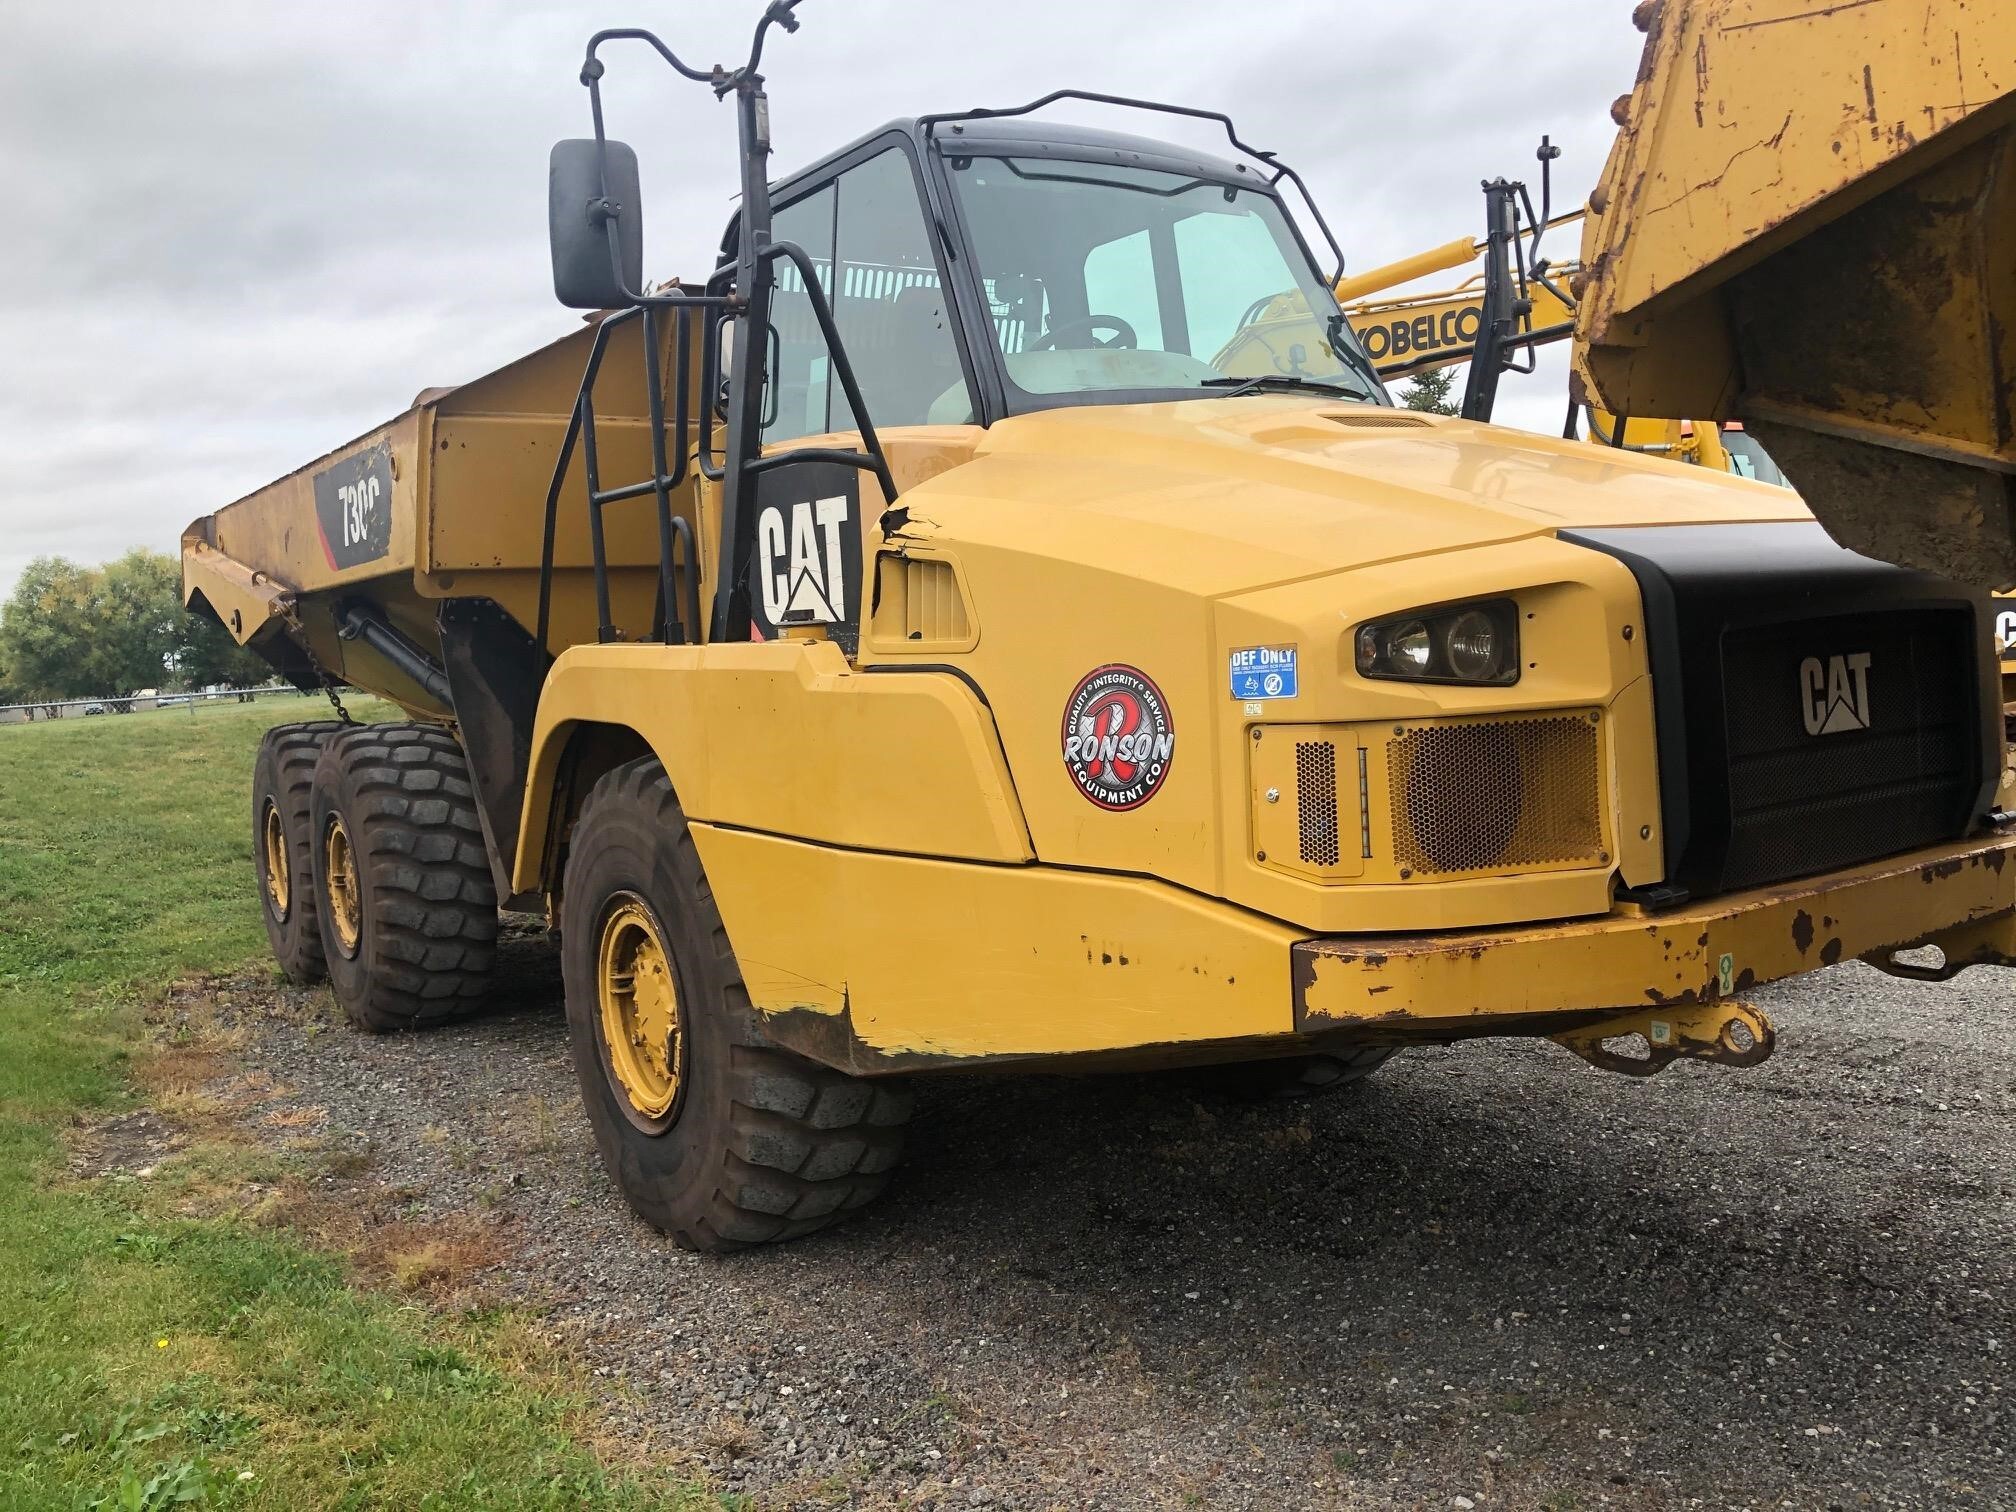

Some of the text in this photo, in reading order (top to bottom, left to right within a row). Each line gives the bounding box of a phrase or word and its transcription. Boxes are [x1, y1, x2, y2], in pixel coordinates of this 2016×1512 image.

[1357, 307, 1482, 360] OBELCO
[759, 495, 848, 625] CAT
[1232, 650, 1257, 667] DEF
[1261, 649, 1294, 665] ONLY
[1068, 674, 1165, 734] QUALITY INTEGRITY SERVICE
[1800, 652, 1871, 736] CAT
[1064, 733, 1175, 762] RONSON
[1073, 759, 1165, 804] EQUIPMENT CO.
